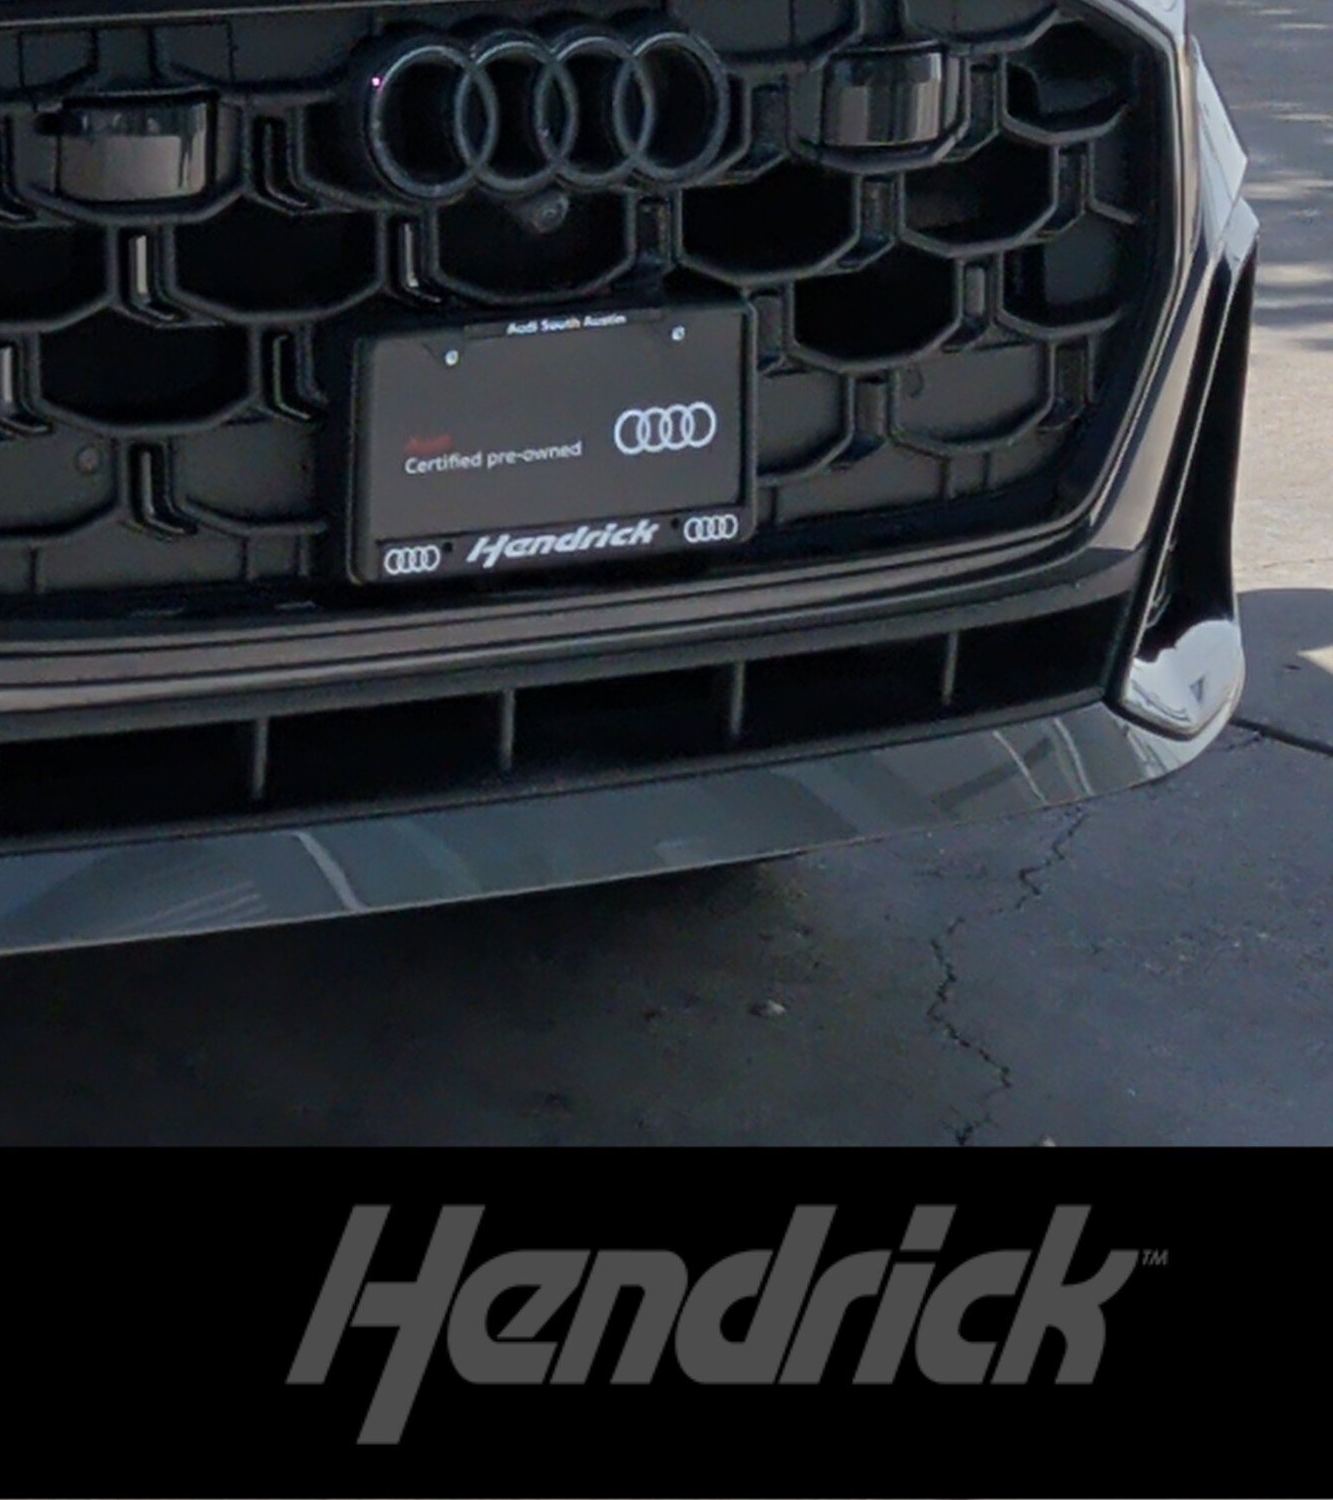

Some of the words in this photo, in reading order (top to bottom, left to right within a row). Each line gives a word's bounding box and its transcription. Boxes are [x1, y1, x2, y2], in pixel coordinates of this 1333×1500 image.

[540, 316, 581, 332] South
[583, 313, 627, 328] Austin
[404, 450, 482, 475] Certified
[486, 440, 583, 470] pre-owned
[466, 518, 660, 569] Hendrick
